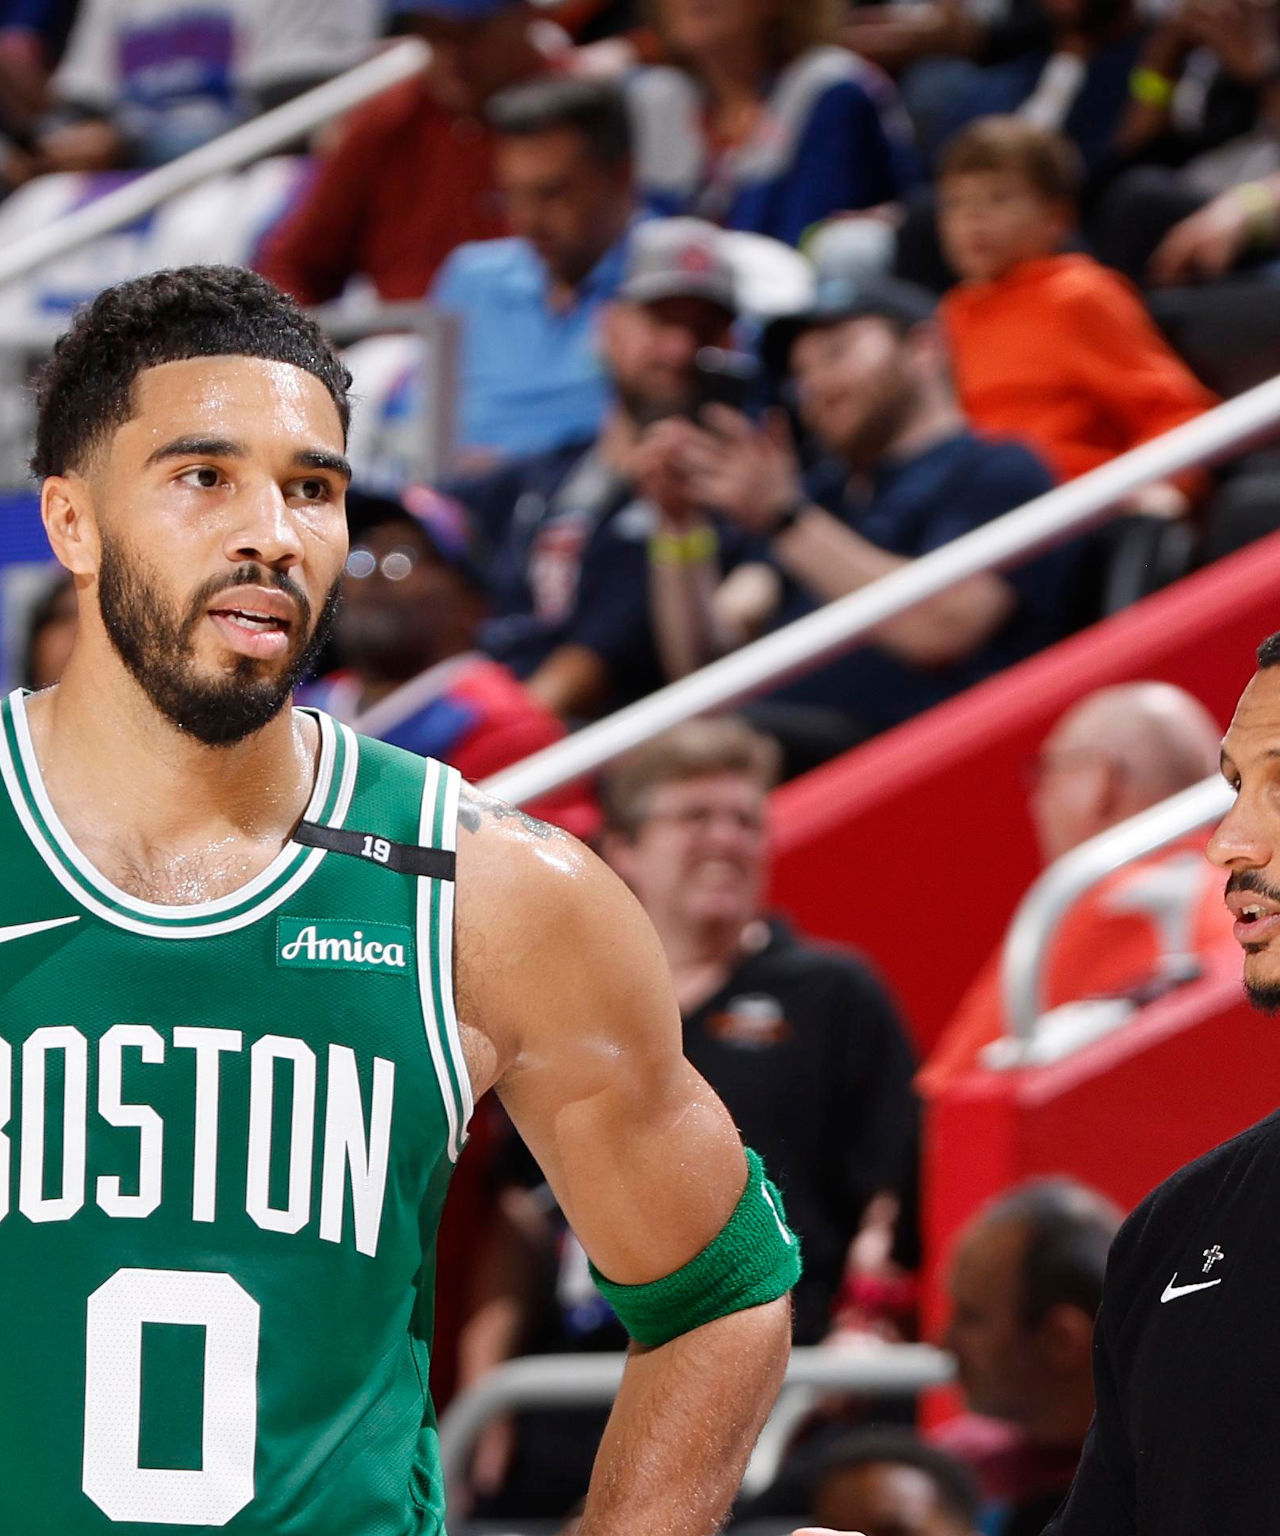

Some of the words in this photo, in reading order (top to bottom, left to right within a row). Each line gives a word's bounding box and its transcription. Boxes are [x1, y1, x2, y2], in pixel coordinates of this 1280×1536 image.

[361, 835, 391, 863] 19
[281, 926, 406, 967] Amica
[82, 1267, 261, 1526] 0
